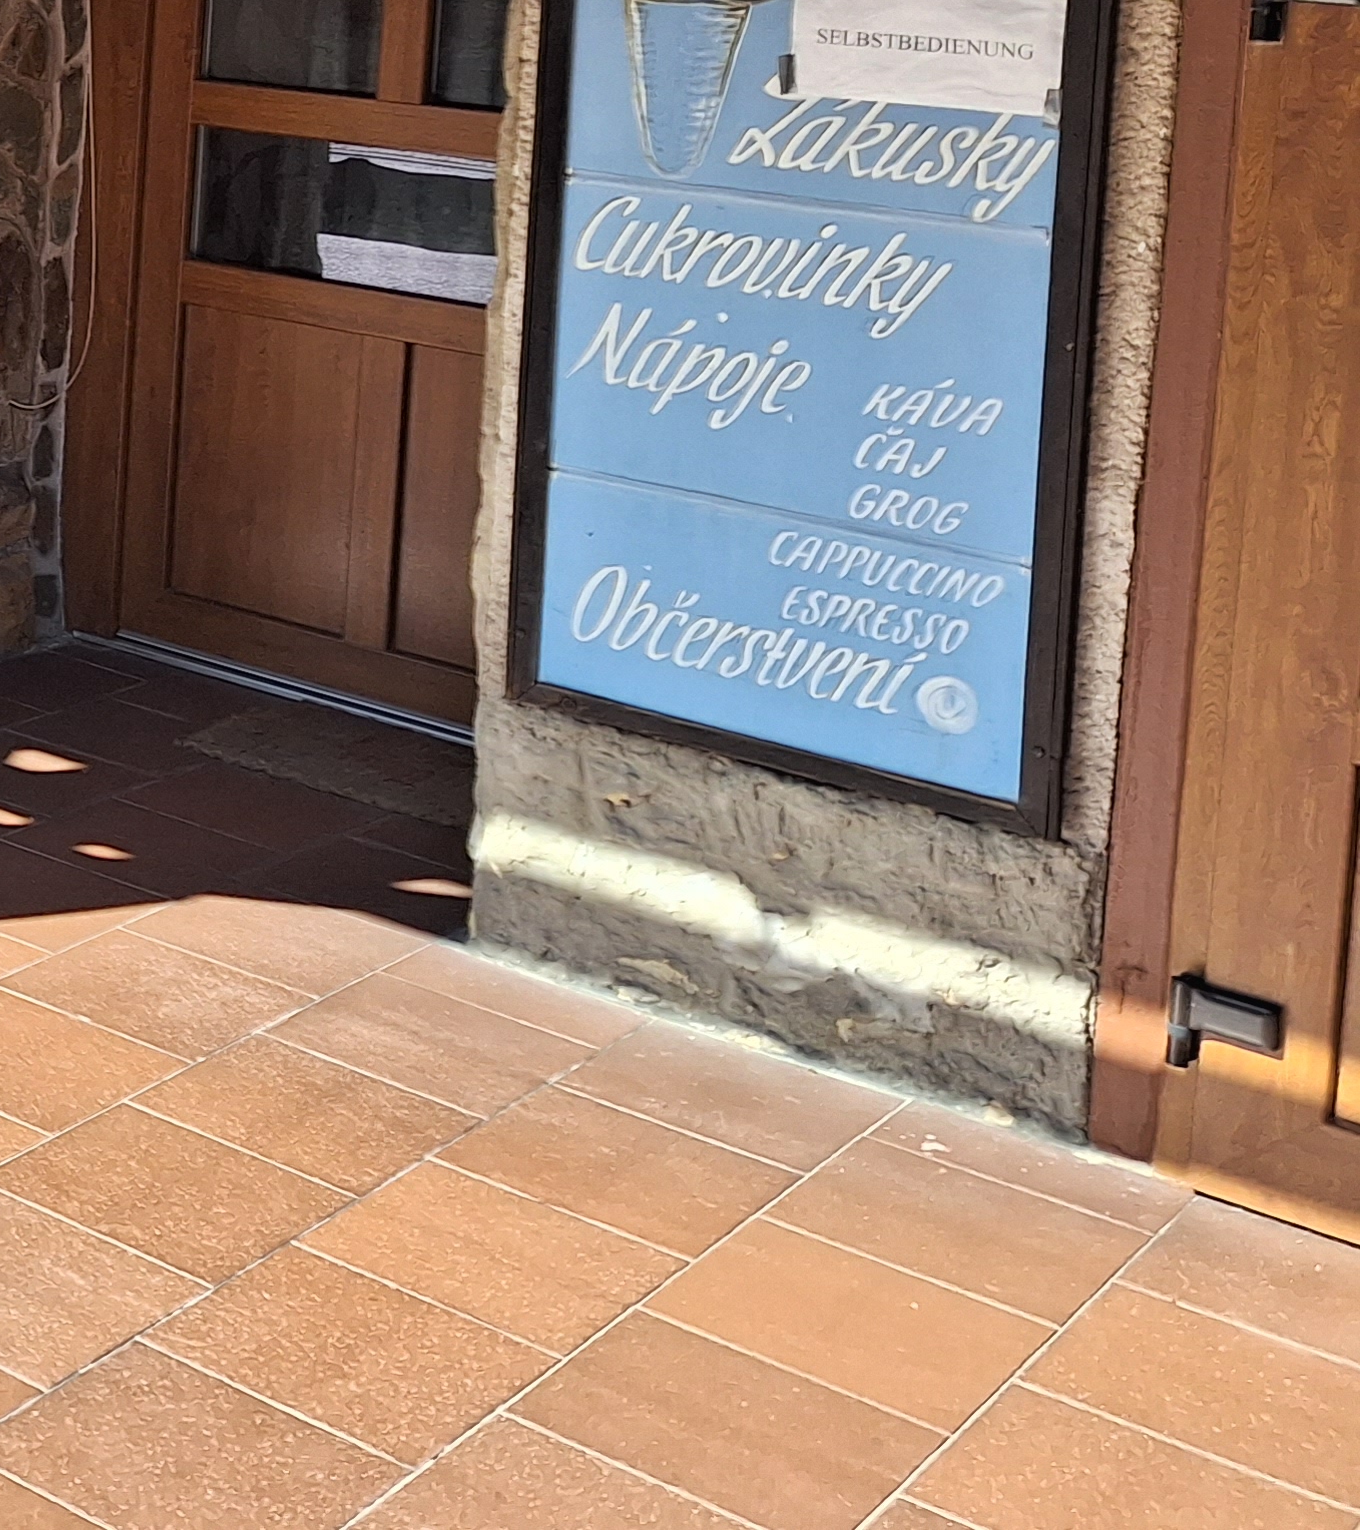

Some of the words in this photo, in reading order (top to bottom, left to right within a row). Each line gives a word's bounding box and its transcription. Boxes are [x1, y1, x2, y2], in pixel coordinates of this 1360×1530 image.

[816, 27, 1035, 60] SELBSTBEDIENUNG
[574, 195, 953, 339] Cukrovinky
[566, 302, 812, 430] Nápoje
[862, 378, 1004, 436] KÁVA
[852, 426, 948, 479] ČAJ
[849, 483, 969, 535] GROG
[768, 531, 1006, 608] CAPPUCCINO
[571, 564, 928, 715] Občerstvení
[781, 585, 970, 654] ESPRESSO
